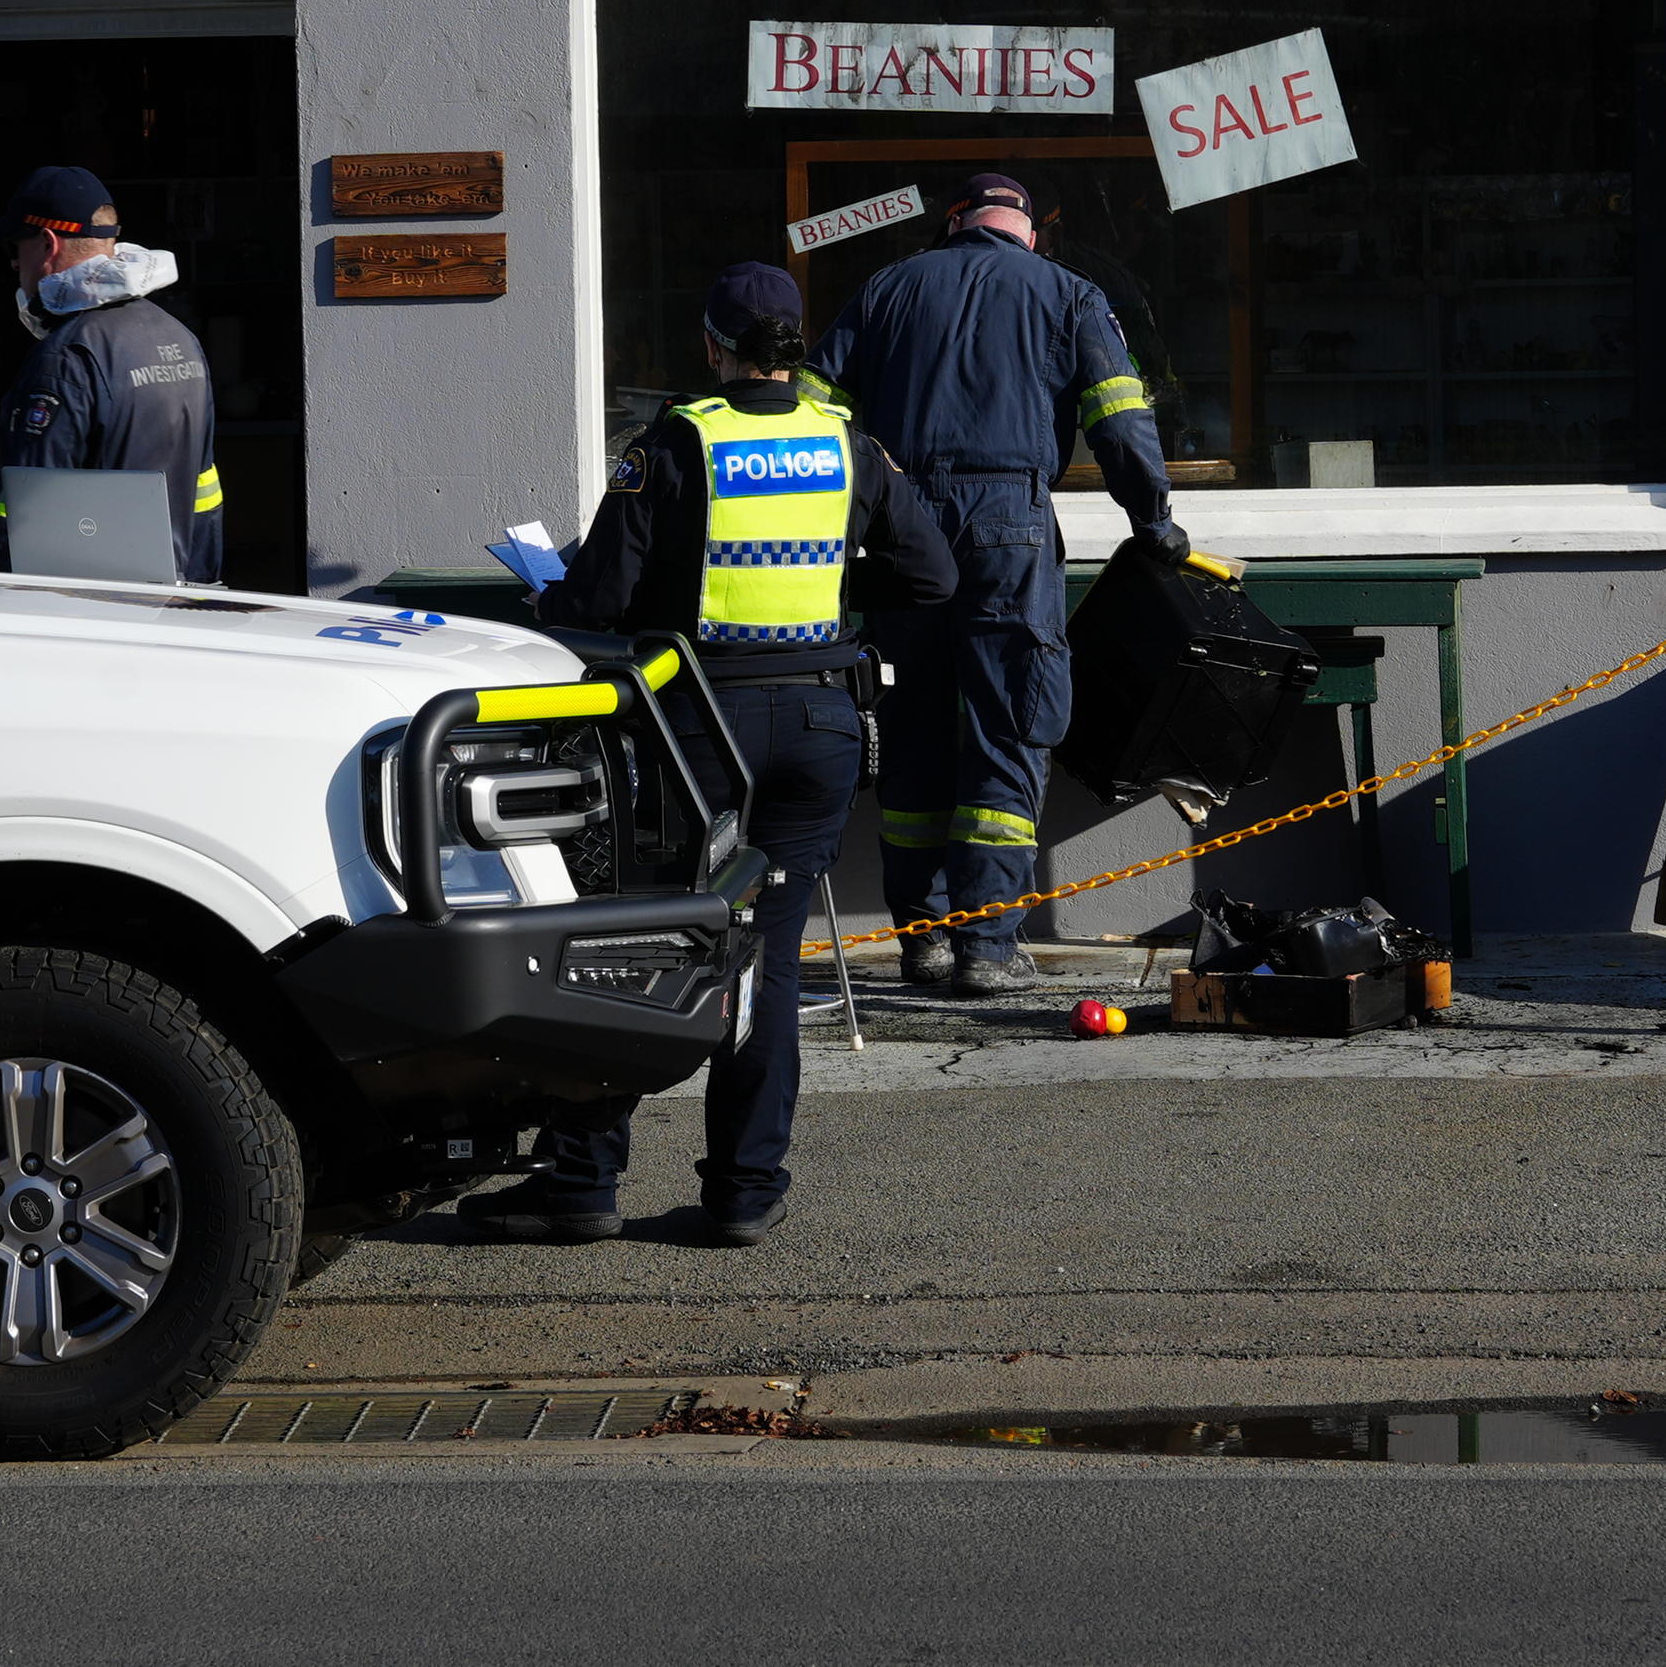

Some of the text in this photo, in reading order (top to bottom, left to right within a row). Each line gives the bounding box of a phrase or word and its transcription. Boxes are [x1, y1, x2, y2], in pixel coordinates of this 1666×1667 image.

[1168, 69, 1324, 159] SALE
[342, 162, 470, 177] We make 'em
[367, 192, 401, 207] You
[408, 190, 452, 206] take
[796, 192, 916, 248] BEANIES
[362, 244, 474, 263] If you like it
[391, 270, 448, 289] Buy it
[156, 343, 184, 362] FIRE
[724, 450, 834, 482] POLICE
